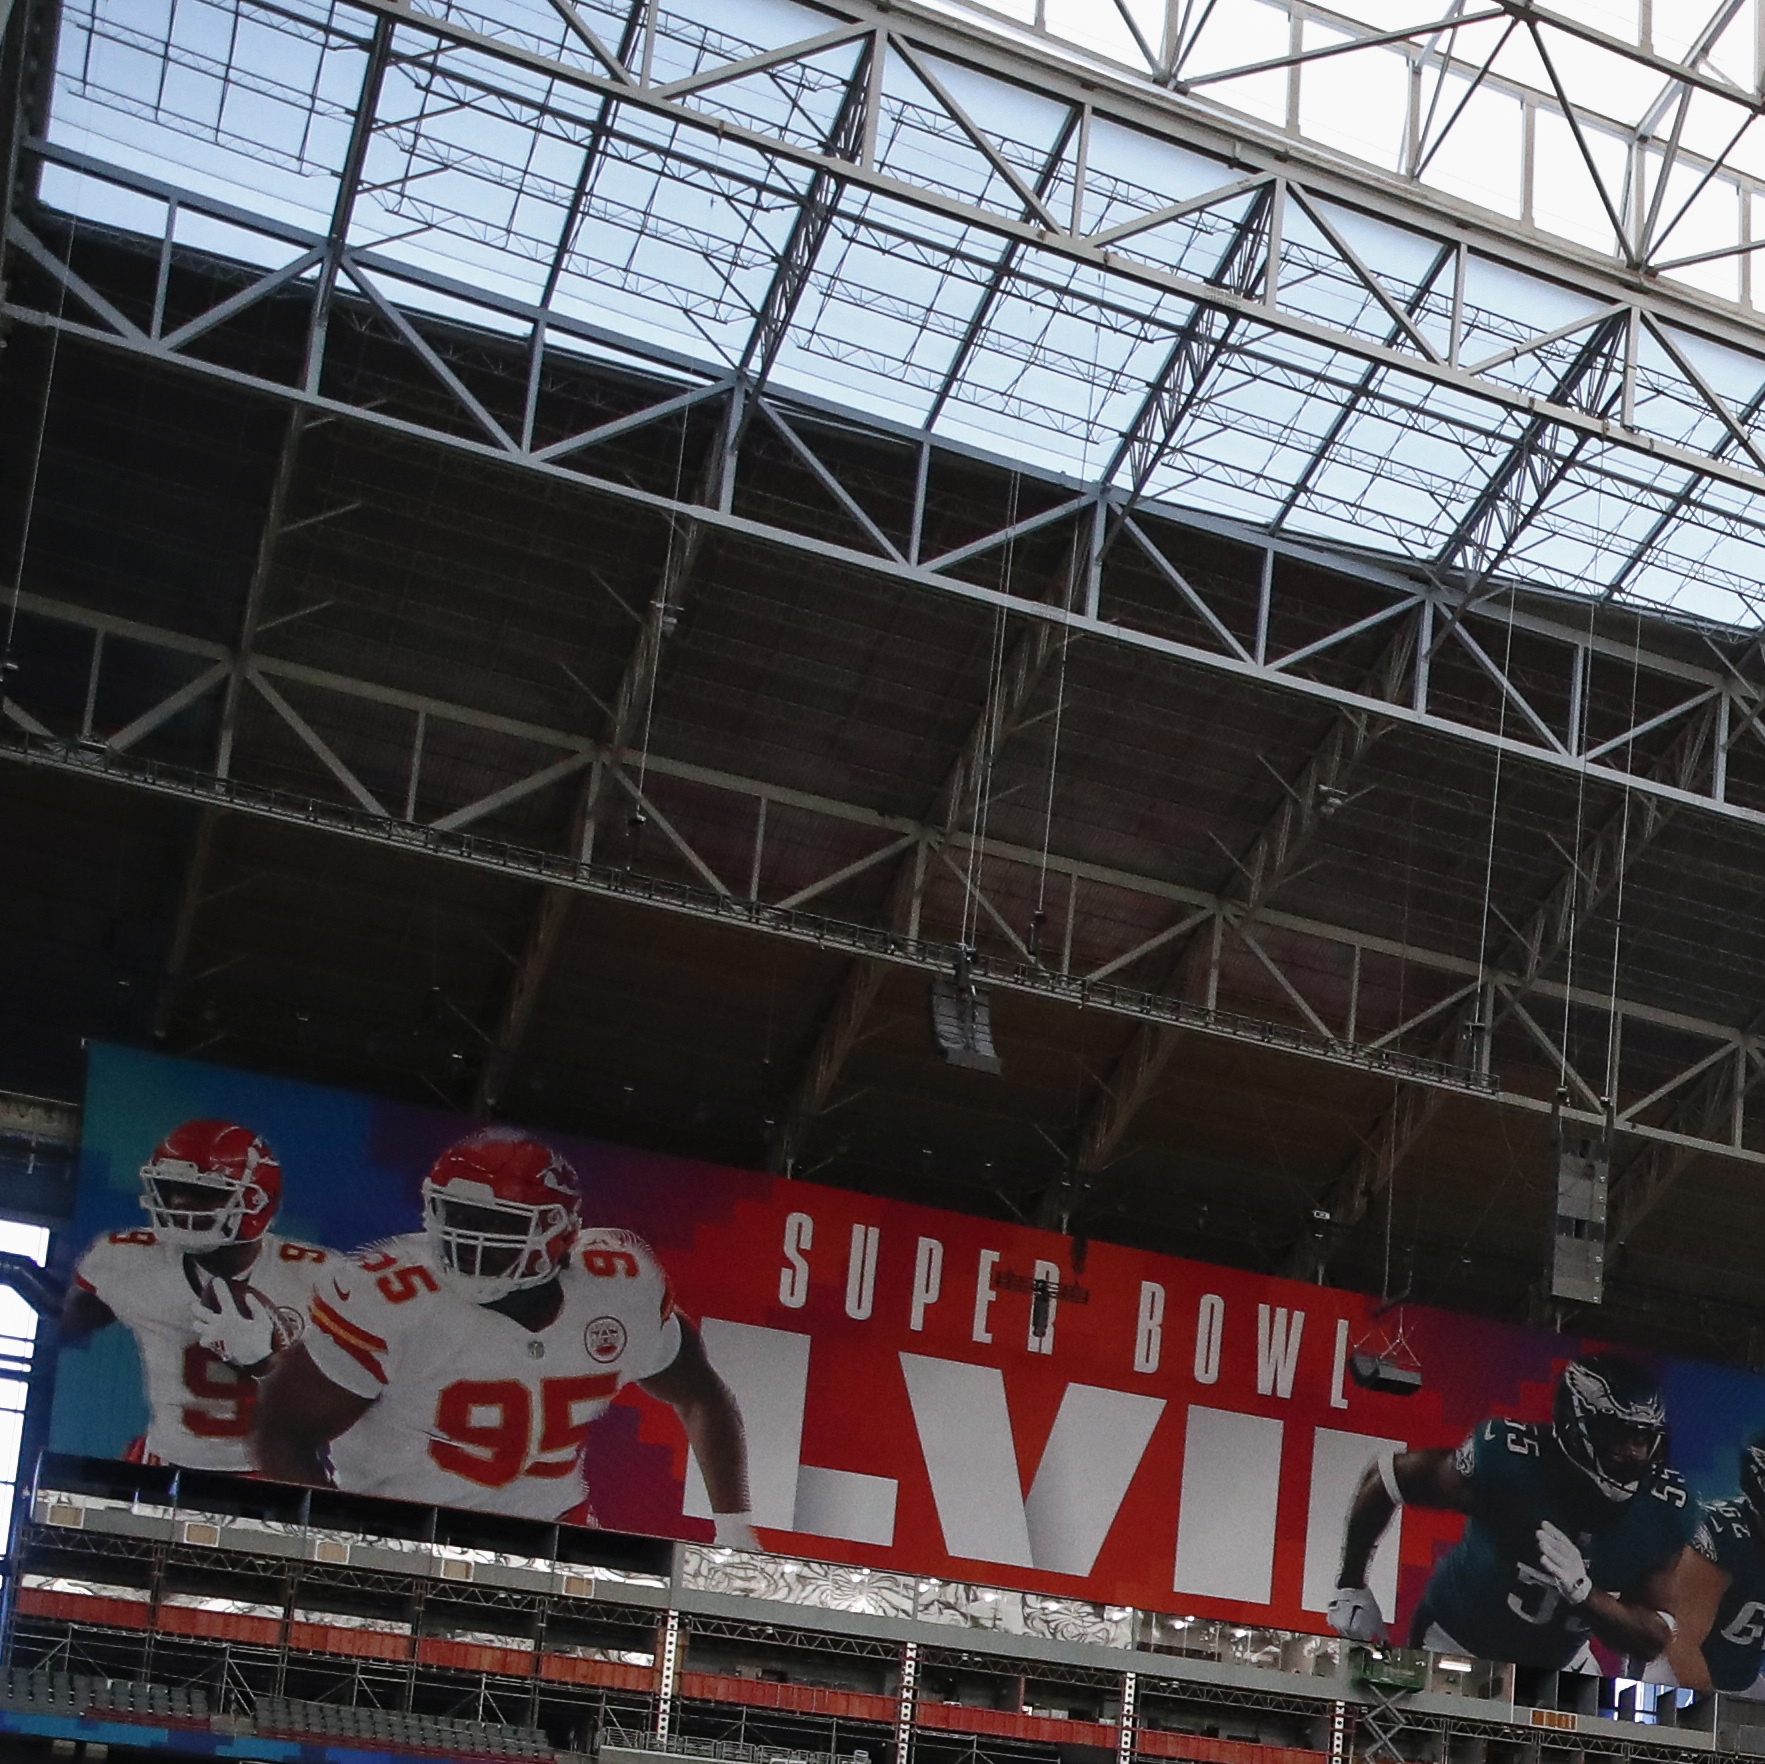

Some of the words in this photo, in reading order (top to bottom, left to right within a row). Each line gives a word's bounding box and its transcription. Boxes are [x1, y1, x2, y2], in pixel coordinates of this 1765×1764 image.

[779, 1212, 1062, 1357] SUPER
[1134, 1280, 1352, 1410] BOWL
[428, 1370, 623, 1486] 95
[683, 1316, 1407, 1625] LVII
